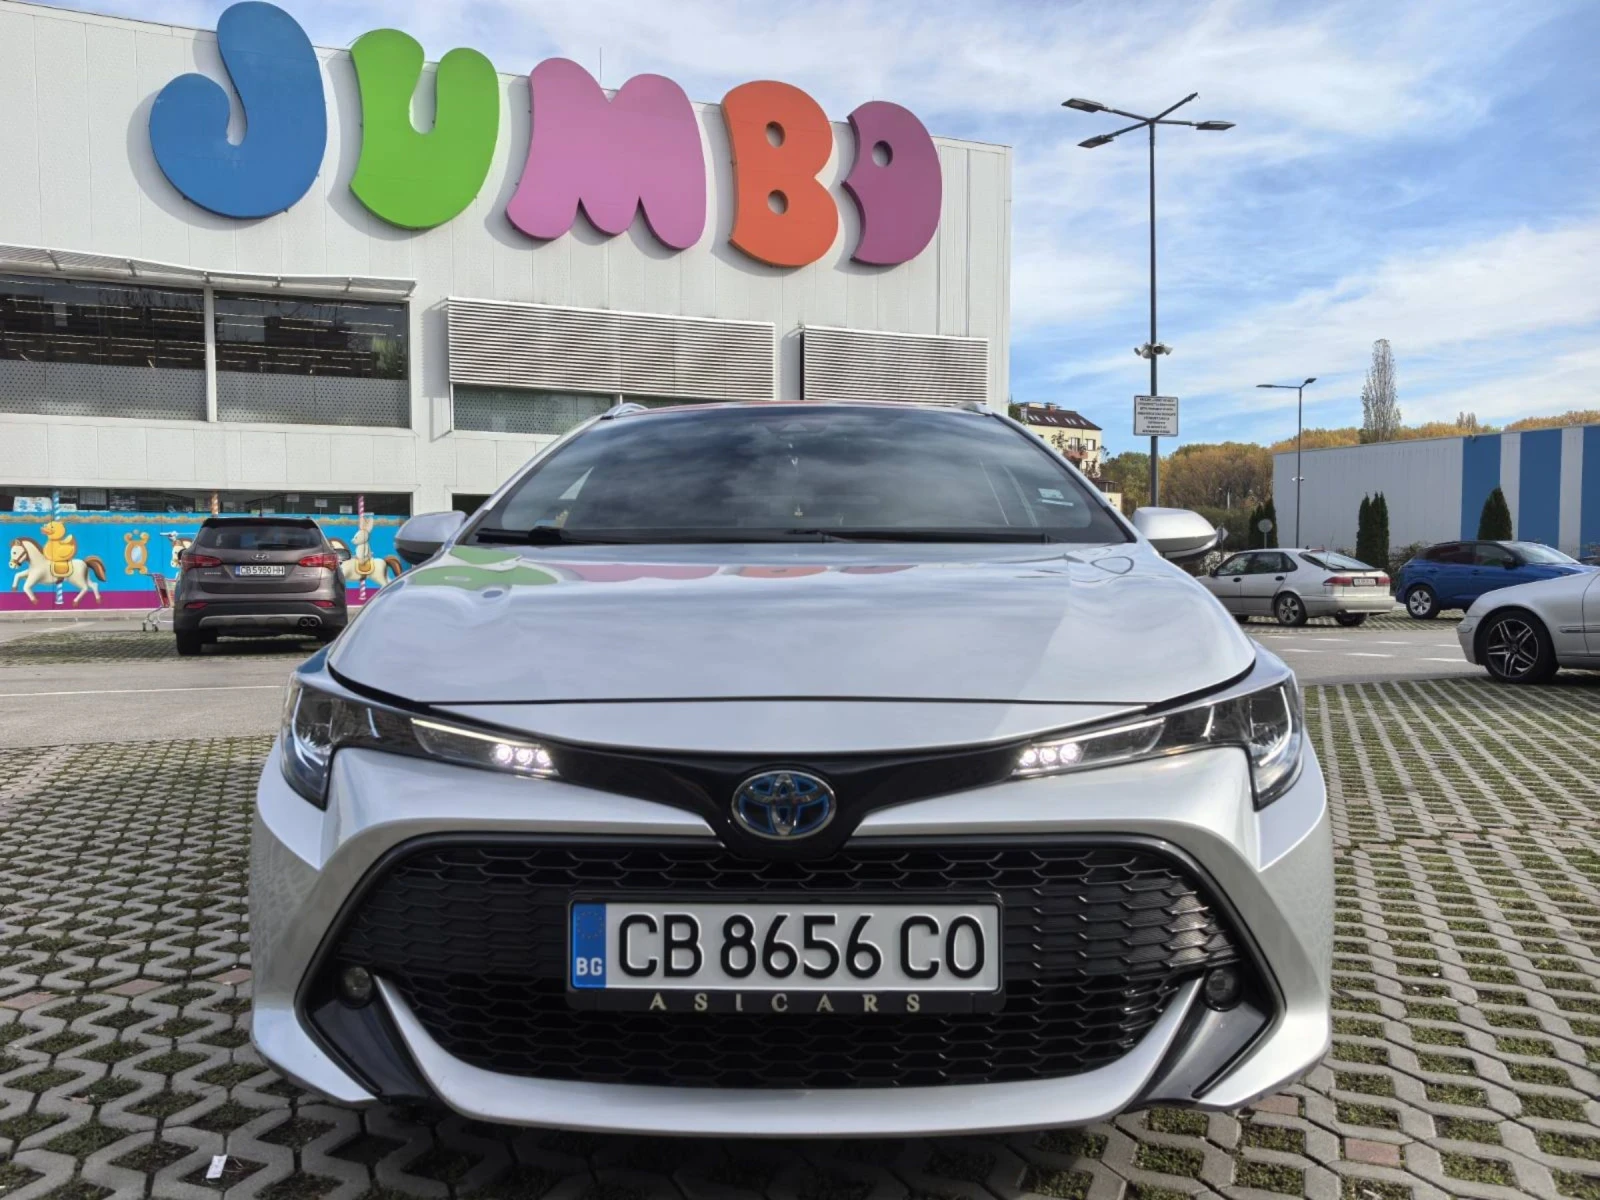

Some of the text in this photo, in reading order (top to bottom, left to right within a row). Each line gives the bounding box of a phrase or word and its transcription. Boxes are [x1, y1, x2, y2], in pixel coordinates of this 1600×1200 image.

[149, 1, 943, 268] JUMBO
[240, 566, 252, 575] CB
[575, 957, 603, 976] BG
[619, 913, 704, 979] CB
[720, 913, 883, 980] 8656
